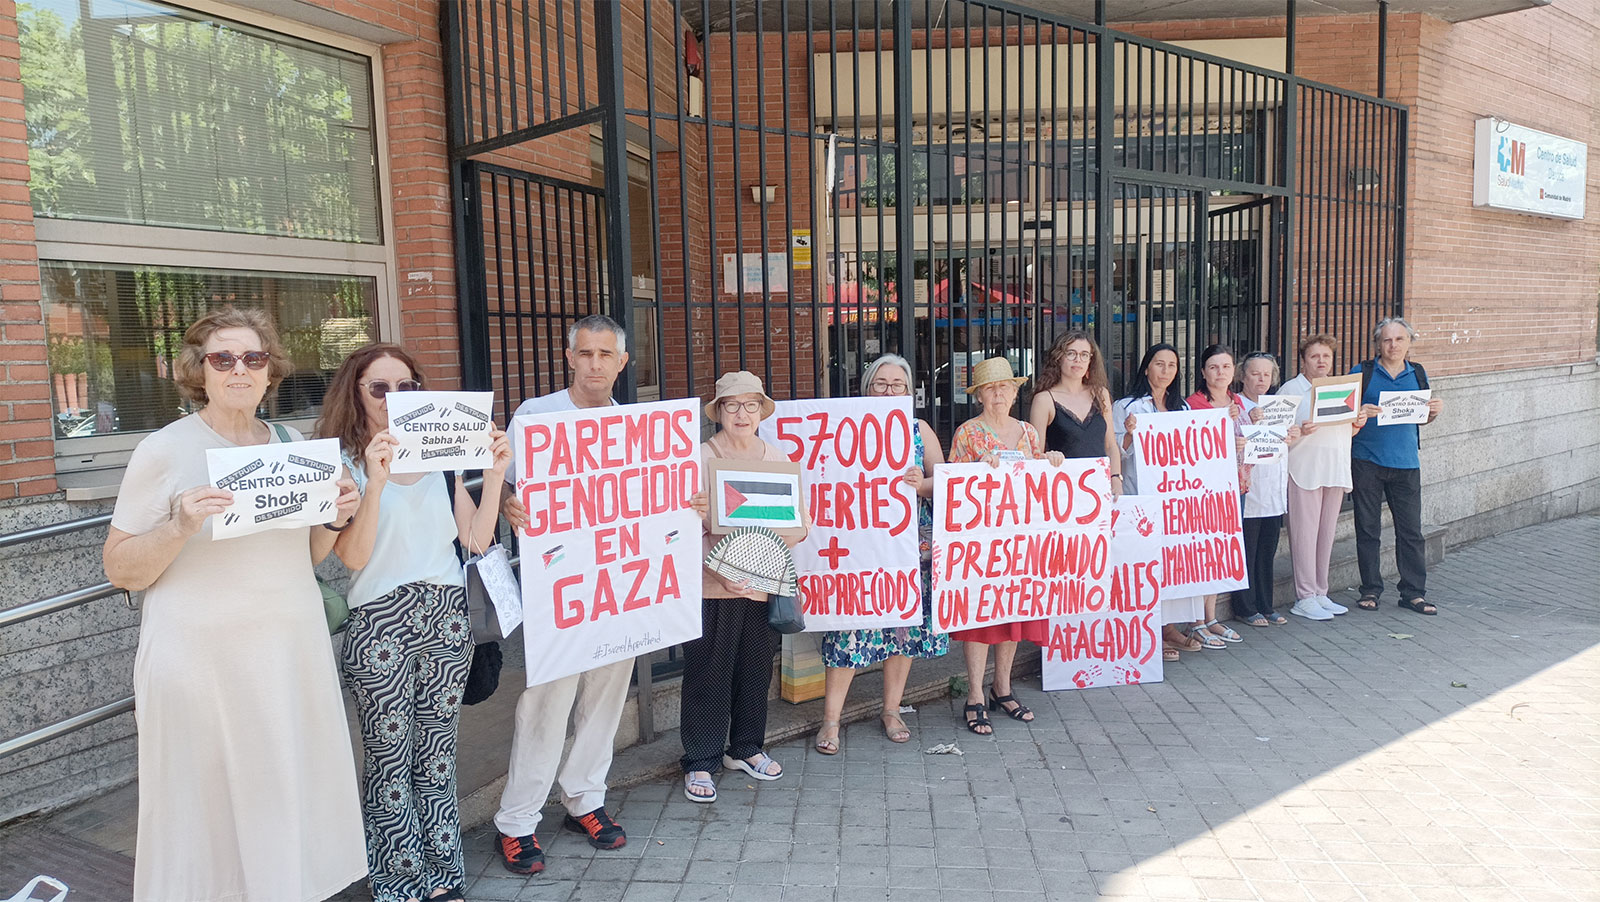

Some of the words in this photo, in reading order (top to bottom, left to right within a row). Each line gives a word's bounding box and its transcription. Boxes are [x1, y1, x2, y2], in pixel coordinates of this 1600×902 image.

[1537, 147, 1554, 162] Centro
[1555, 153, 1561, 164] de
[1563, 153, 1577, 167] Salud
[393, 403, 435, 426] DESTRUIDO
[404, 423, 449, 432] CENTRO
[453, 422, 486, 431] SALUD
[421, 436, 452, 445] Sabha
[455, 435, 469, 444] Al-
[777, 409, 911, 471] 57000
[288, 454, 336, 474] DESTRUIDO
[524, 409, 693, 479] PAREMOS
[216, 458, 264, 489] DESTRUIDO
[229, 475, 285, 491] CENTRO
[288, 471, 331, 485] SALUD
[517, 478, 528, 490] EL
[523, 460, 699, 538] GENOCIDIO
[255, 491, 308, 509] Shoka
[255, 503, 302, 523] DESTRUIDO
[809, 472, 912, 537] ERTES
[944, 468, 1101, 532] ESTAMOS
[595, 523, 640, 565] EN
[945, 531, 1107, 582] PRESENCIANDO
[1161, 535, 1244, 588] UMANITARIO
[553, 554, 681, 629] GAZA
[798, 568, 921, 620] SAPARECIDOS
[938, 586, 969, 630] UN
[975, 576, 1105, 623] EXTERMINIO
[1110, 560, 1159, 613] ALES
[1047, 613, 1157, 665] ATACADOS
